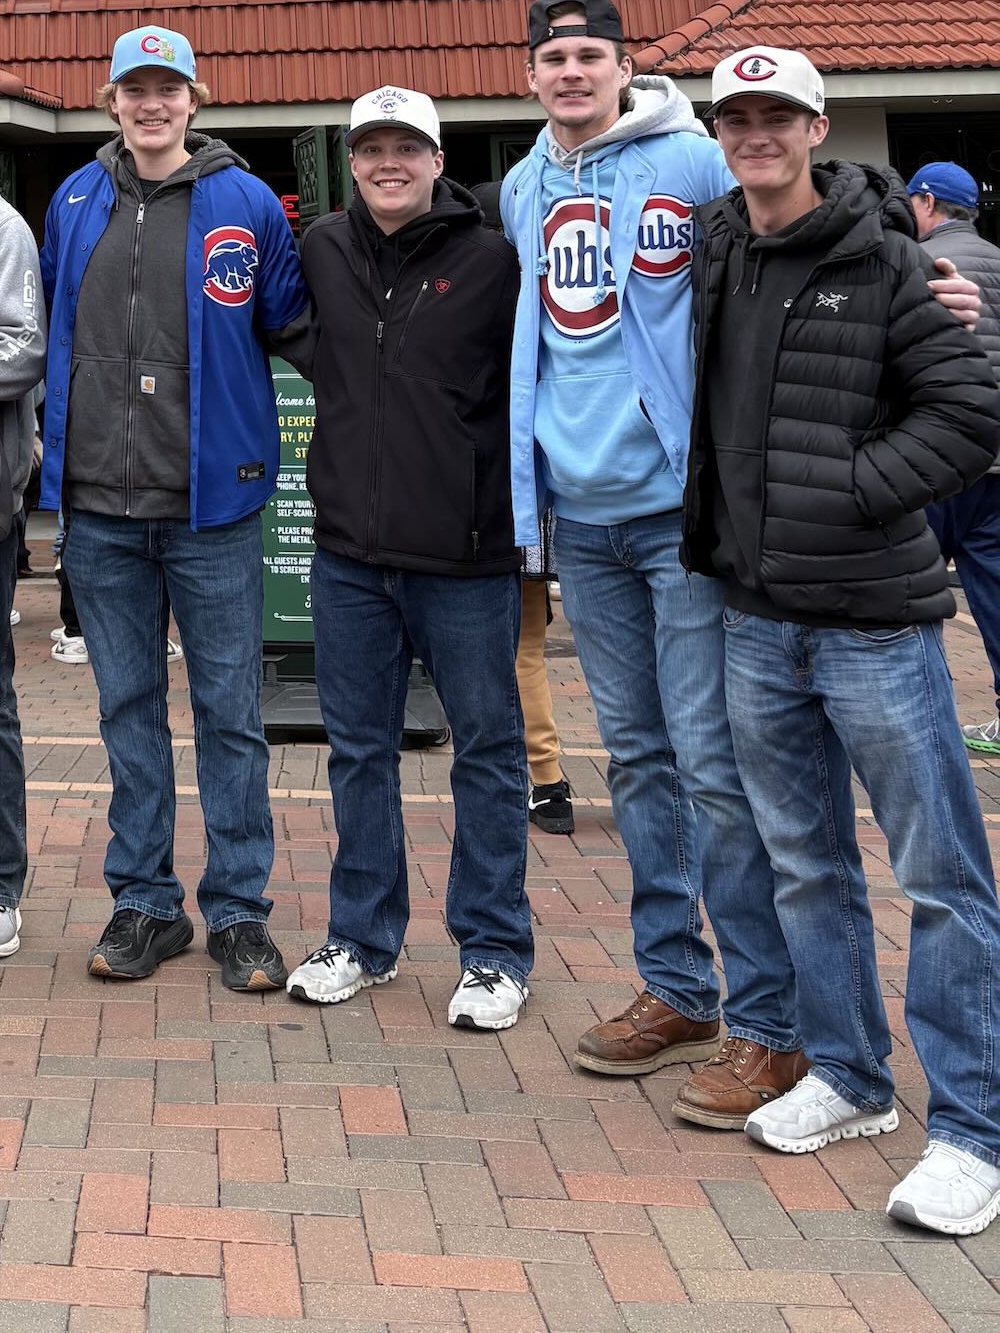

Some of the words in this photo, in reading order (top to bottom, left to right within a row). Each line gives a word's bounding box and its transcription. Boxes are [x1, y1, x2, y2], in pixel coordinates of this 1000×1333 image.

[371, 89, 409, 106] CHICAGO
[305, 394, 316, 406] to
[276, 499, 293, 508] SCAN
[294, 499, 312, 508] YOUR
[277, 526, 300, 535] PLEASE
[278, 535, 290, 544] THE
[291, 535, 312, 544] METAL
[273, 556, 297, 566] GUESTS
[298, 556, 312, 566] AND
[270, 565, 279, 574] TO
